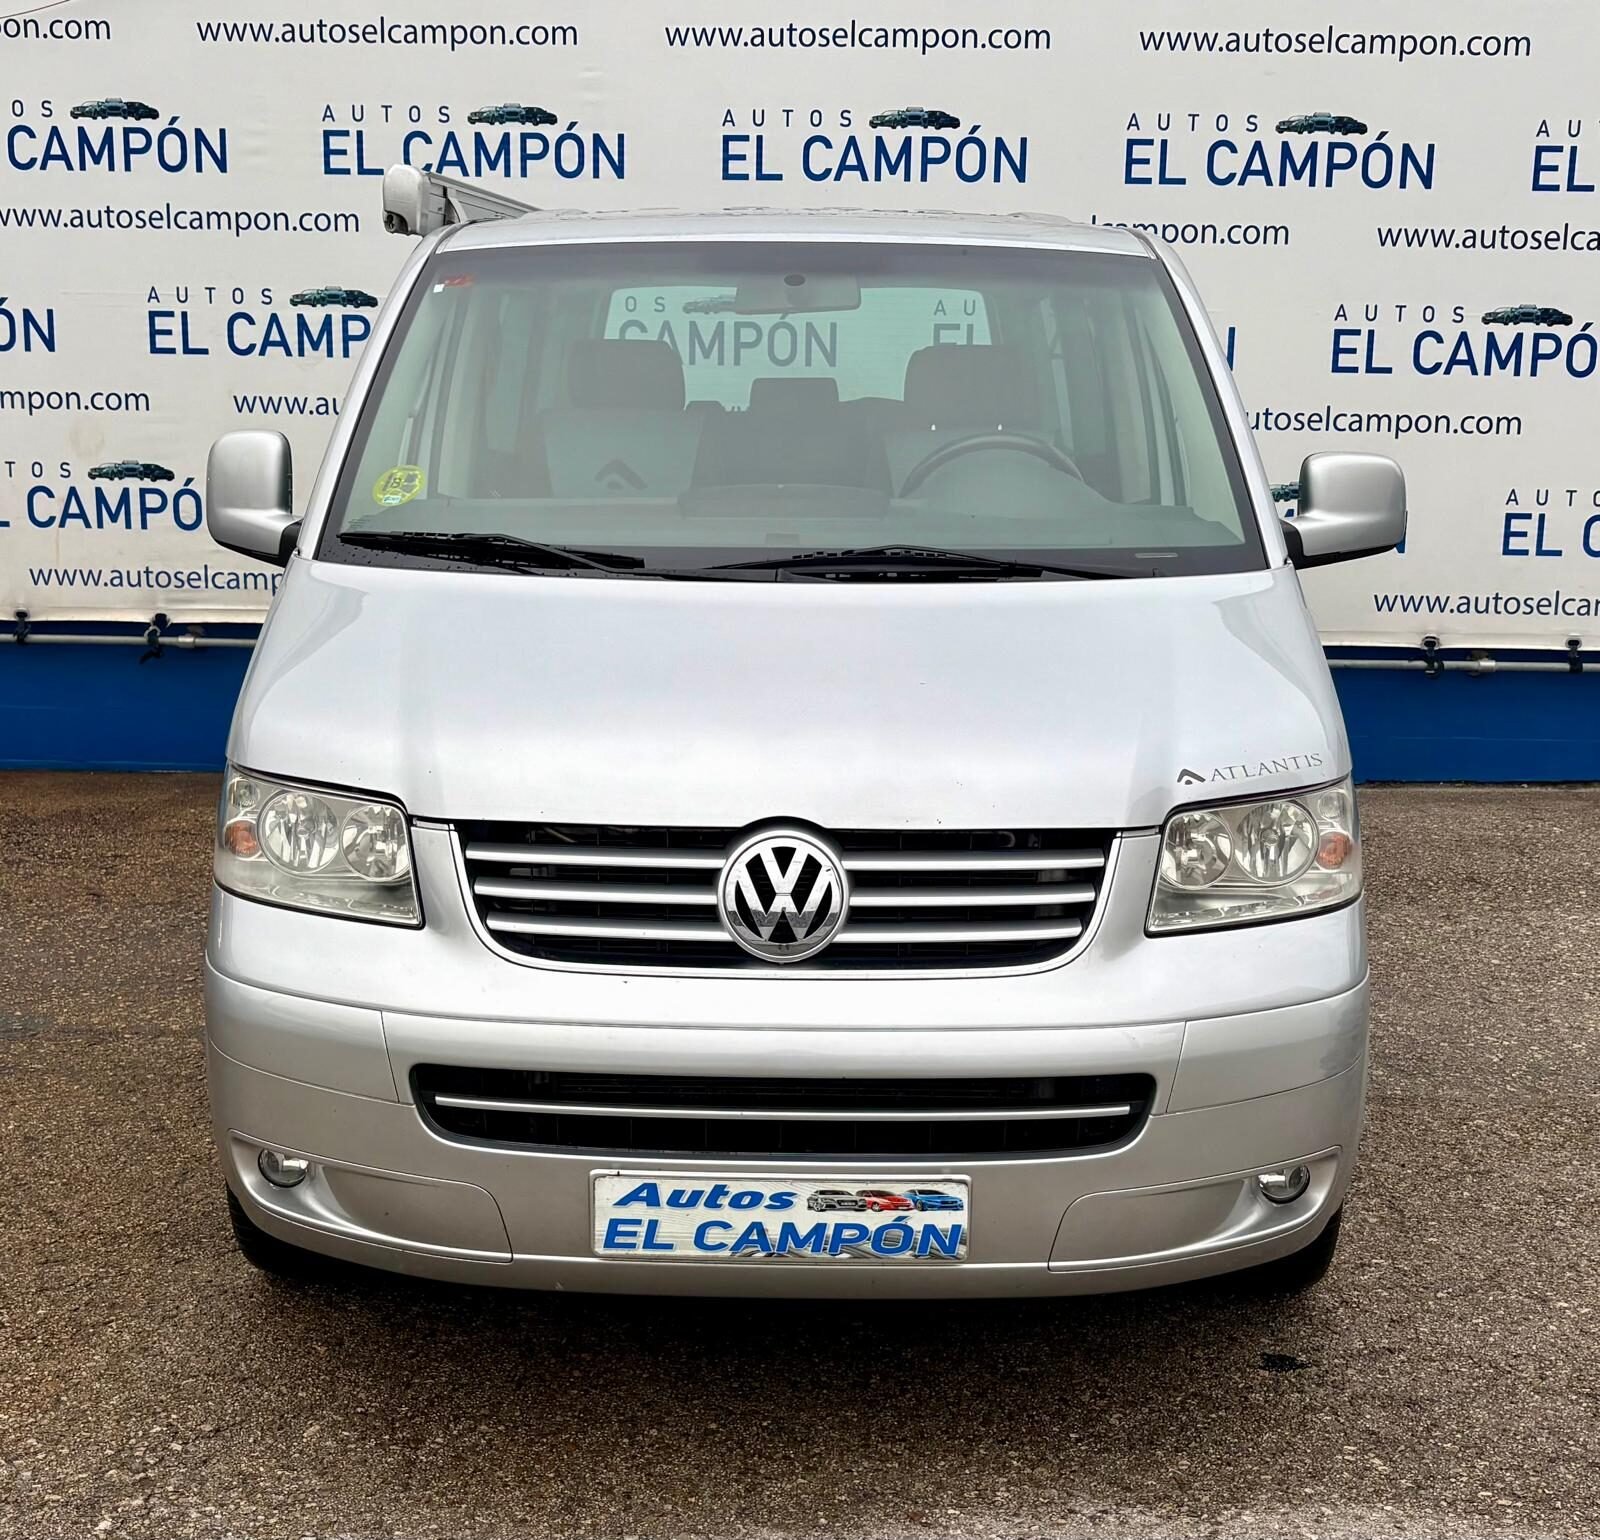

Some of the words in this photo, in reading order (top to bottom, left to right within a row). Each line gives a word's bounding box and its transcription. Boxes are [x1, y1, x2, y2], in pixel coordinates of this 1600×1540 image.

[0, 17, 111, 40] on.com
[196, 15, 578, 52] www.autoselcampon.com
[664, 19, 1051, 56] www.autoselcampon.com
[1139, 25, 1531, 63] www.autoselcampon.com
[321, 104, 450, 123] AUTOS
[722, 108, 852, 128] AUTOS
[1126, 112, 1258, 133] AUTOS
[7, 116, 228, 174] CAMPÓN
[322, 129, 385, 176] EL
[402, 121, 625, 179] CAMPÓN
[721, 134, 784, 181] EL
[802, 125, 1028, 184] CAMPÓN
[1124, 138, 1187, 186] EL
[1206, 131, 1435, 190] CAMPÓN
[1531, 145, 1595, 193] EL
[147, 286, 273, 305] AUTOS
[1334, 303, 1465, 324] AUTOS
[148, 310, 210, 356] EL
[226, 311, 371, 359] CAMP
[1331, 328, 1393, 375] EL
[1412, 322, 1598, 379] CAMPÓ
[26, 477, 203, 532] CAMPÓ
[1501, 512, 1563, 557] EL
[1373, 590, 1600, 617] www.autoselca
[1211, 752, 1324, 783] ATLANTIS
[613, 1182, 799, 1211] Autos
[602, 1217, 675, 1252] EL
[693, 1216, 966, 1256] CAMPÓN
